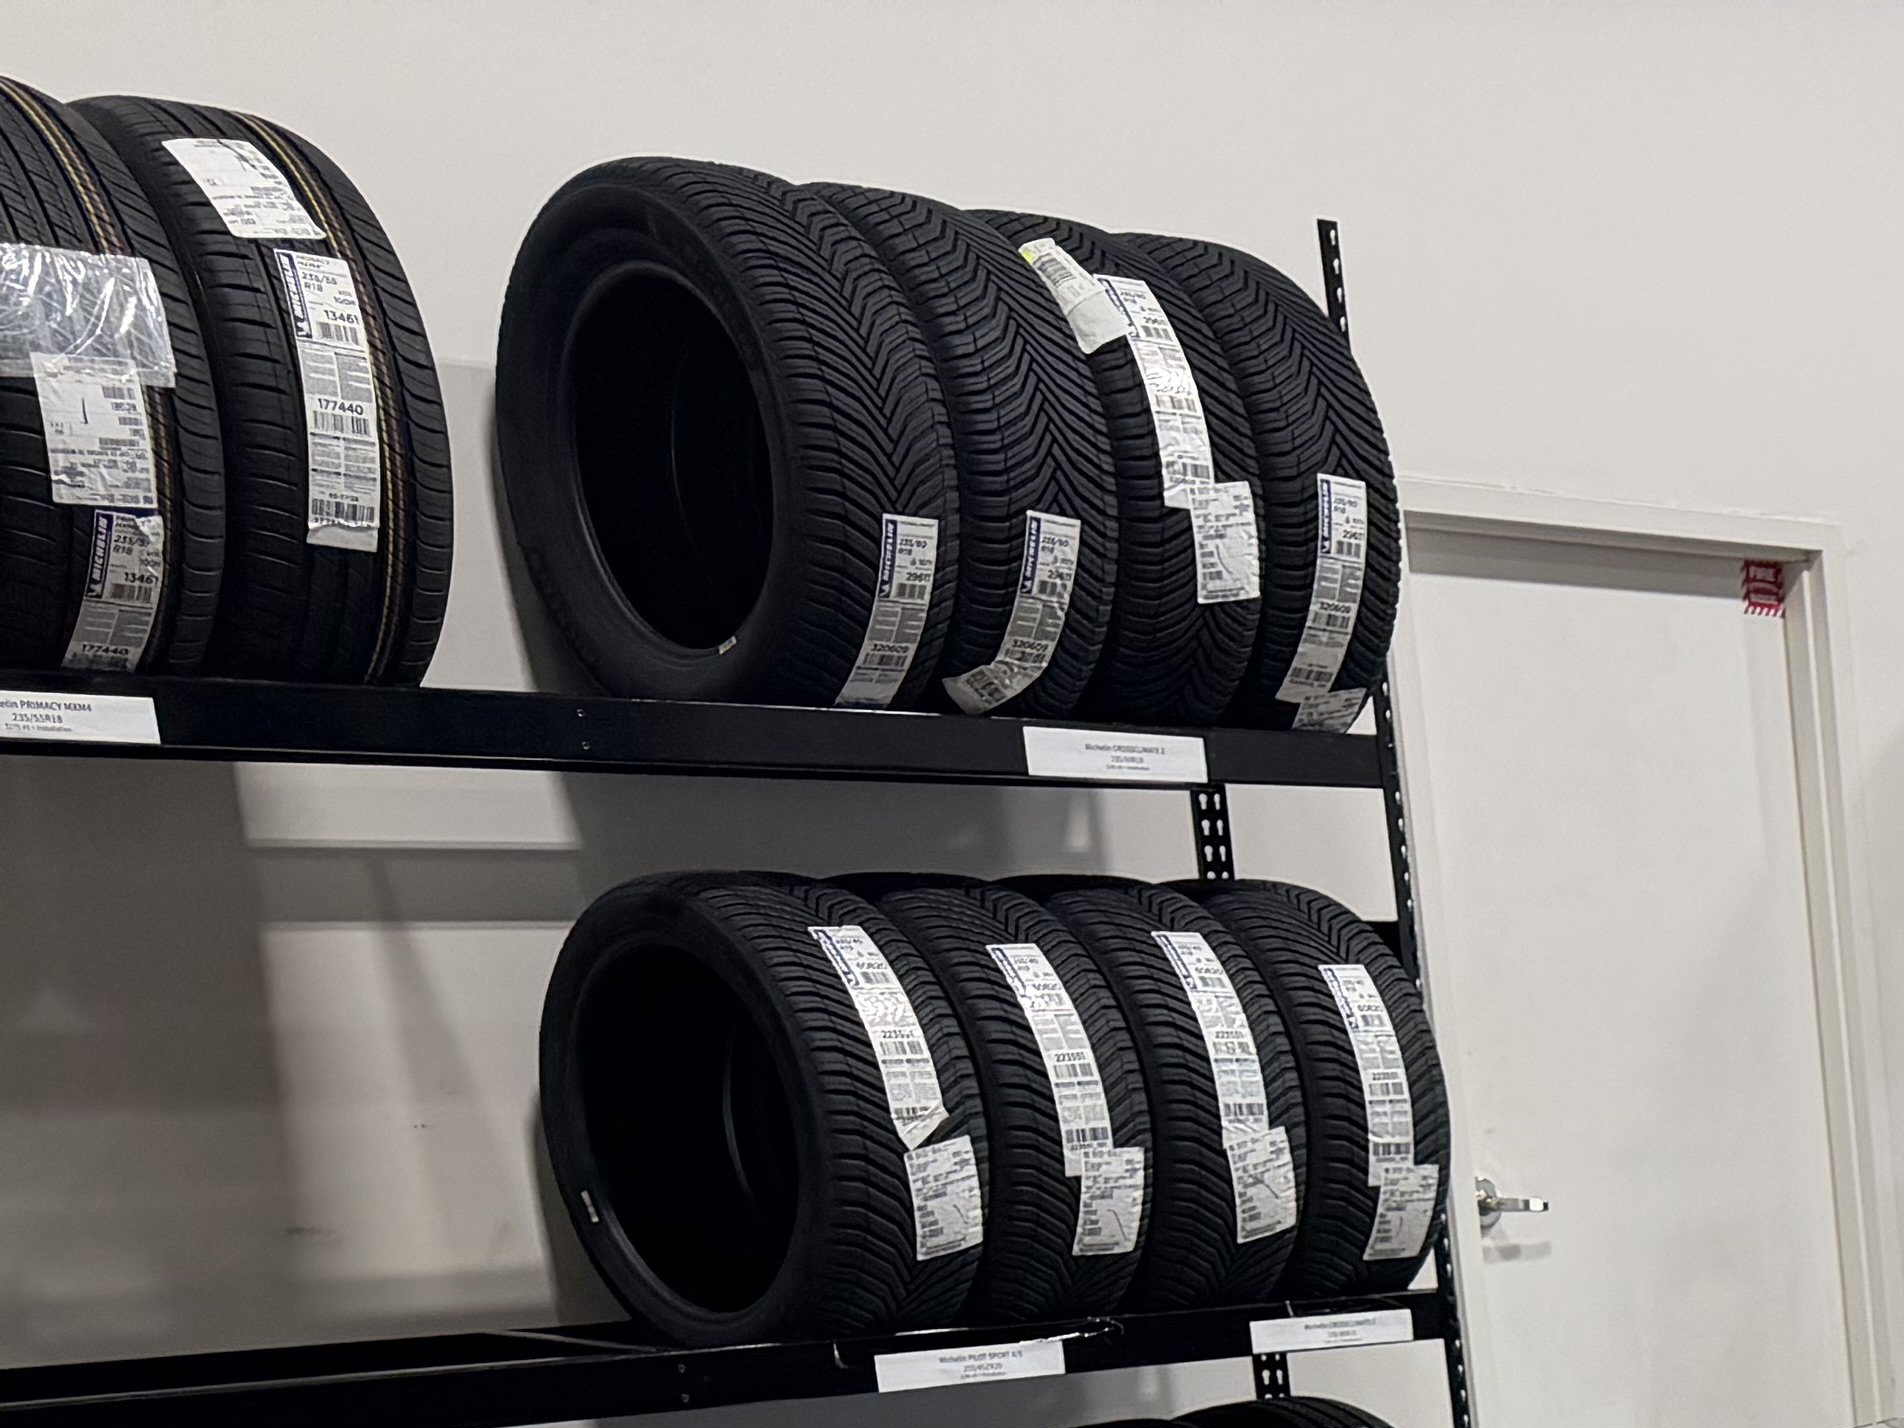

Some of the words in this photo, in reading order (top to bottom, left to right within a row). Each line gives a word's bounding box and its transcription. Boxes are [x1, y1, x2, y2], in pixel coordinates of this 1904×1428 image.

[324, 309, 360, 324] 13461
[318, 398, 364, 416] 177440
[124, 572, 159, 585] 13461
[20, 700, 62, 711] PRIMACY
